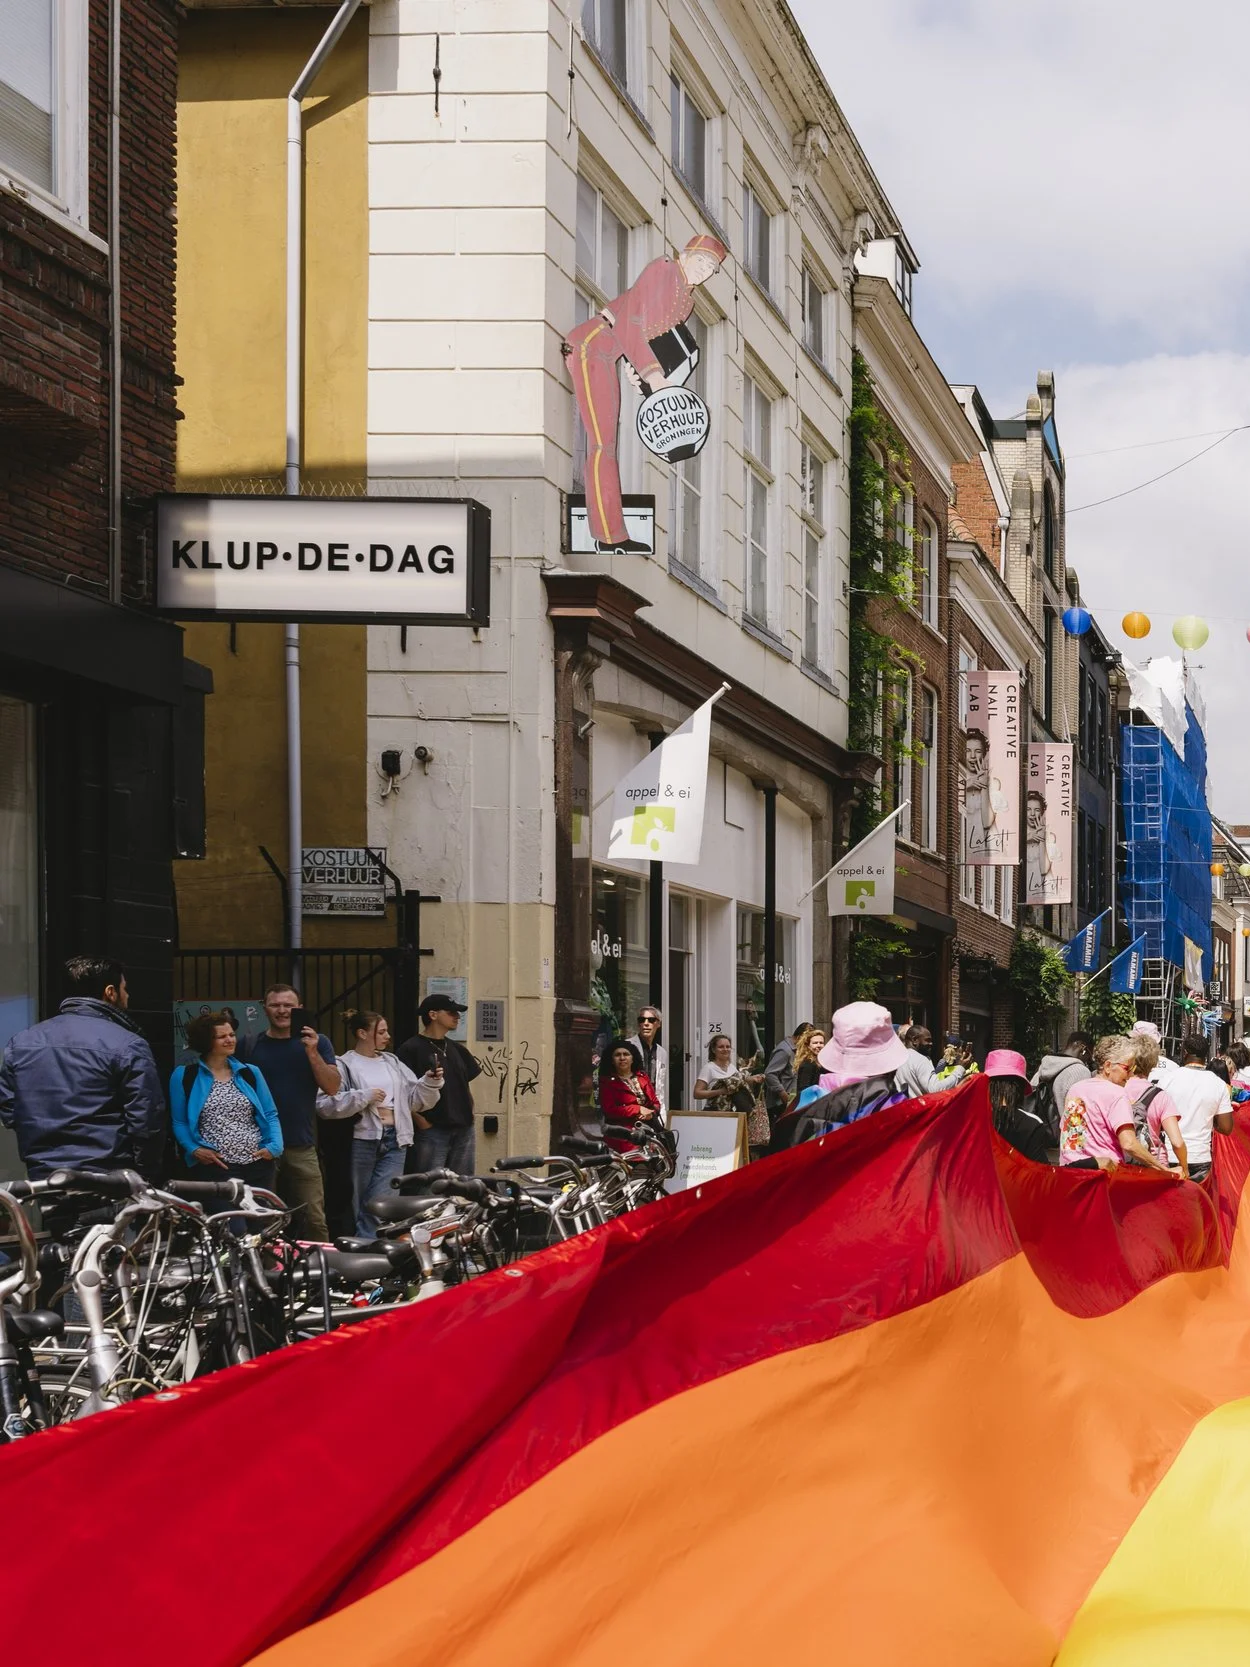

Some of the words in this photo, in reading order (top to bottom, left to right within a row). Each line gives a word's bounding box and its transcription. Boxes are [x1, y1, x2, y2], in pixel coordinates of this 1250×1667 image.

[640, 393, 702, 431] KOSTUUM
[644, 411, 705, 444] VERHUUR
[656, 427, 702, 449] GRONINGEN
[969, 684, 980, 712] LAB
[988, 684, 998, 720] NAIL
[1006, 684, 1017, 758] CREATIVE
[1030, 754, 1039, 777] LAB
[1046, 754, 1055, 785] NAIL
[625, 782, 661, 801] appel
[664, 784, 675, 797] &
[678, 786, 691, 799] ei
[1061, 754, 1070, 817] CREATIVE
[301, 850, 382, 866] KOSTUUM
[836, 865, 864, 877] appel
[866, 865, 874, 875] &
[876, 866, 885, 875] ei
[302, 867, 381, 884] VERHUUR
[612, 937, 622, 958] ei
[1084, 923, 1093, 967] MAMAMINI
[1128, 951, 1137, 990] MAMAMINI
[709, 1023, 722, 1034] 25
